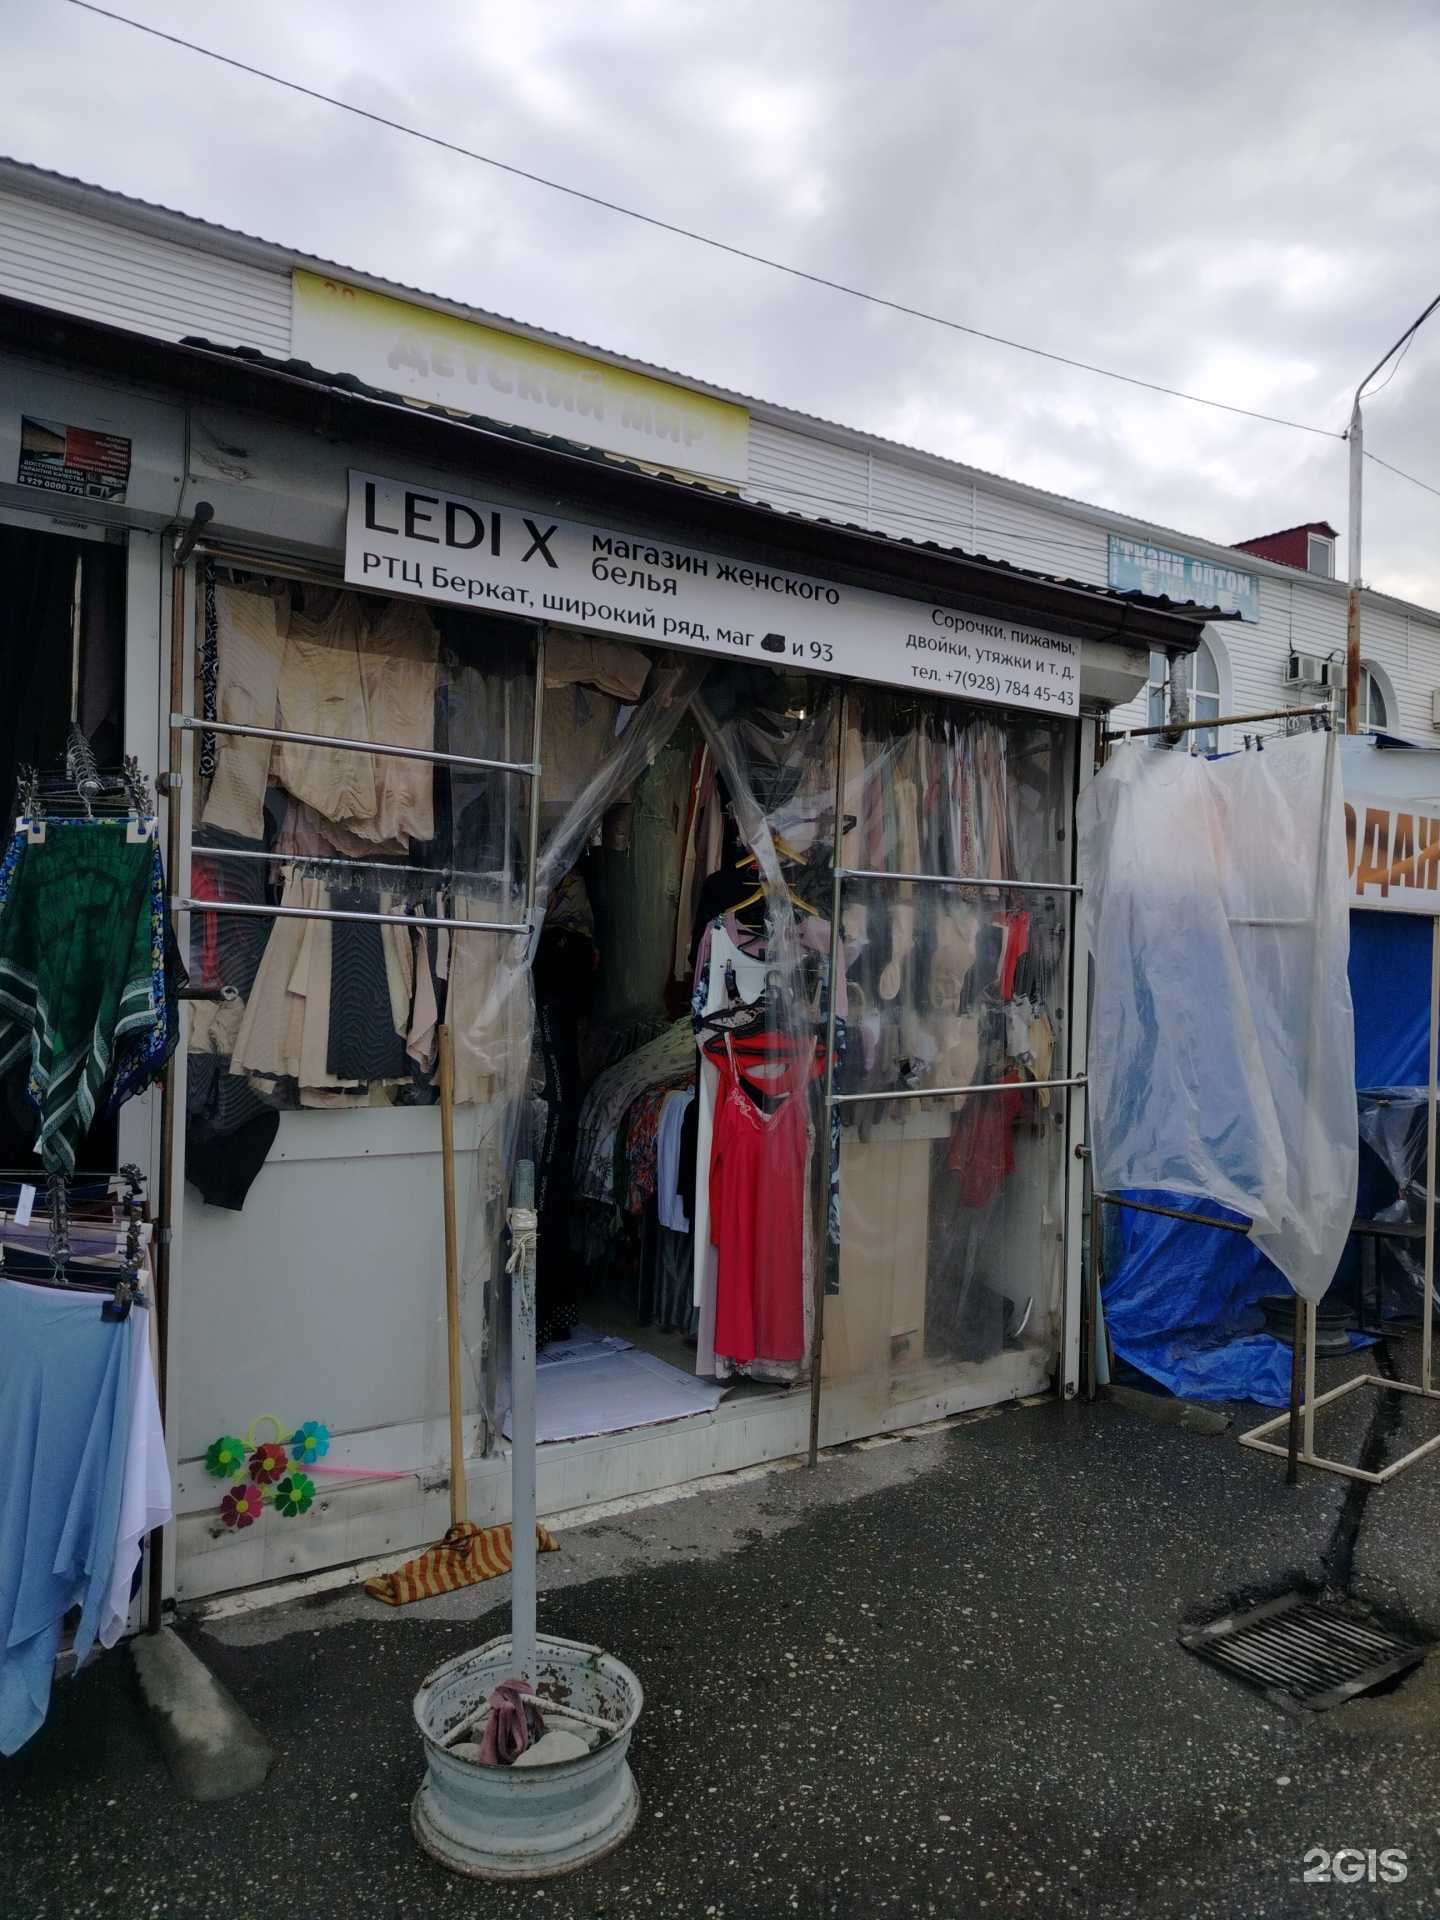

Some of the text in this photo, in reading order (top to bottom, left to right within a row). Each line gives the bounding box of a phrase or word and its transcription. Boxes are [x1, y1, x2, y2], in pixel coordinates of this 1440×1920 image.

[365, 482, 559, 568] LEDI X
[592, 557, 678, 596] белья
[593, 535, 839, 605] магазин женского
[363, 552, 423, 588] РТЦ
[432, 566, 534, 607] Беркат,
[543, 594, 655, 629] широкий
[663, 616, 710, 641] ряд,
[716, 628, 755, 647] маг
[792, 642, 803, 657] и
[810, 641, 833, 662] 93
[906, 633, 971, 660] двойки,
[976, 648, 1032, 670] утяжки
[1036, 660, 1045, 673] и
[911, 665, 1074, 706] тел. +7(928) 784 45-43
